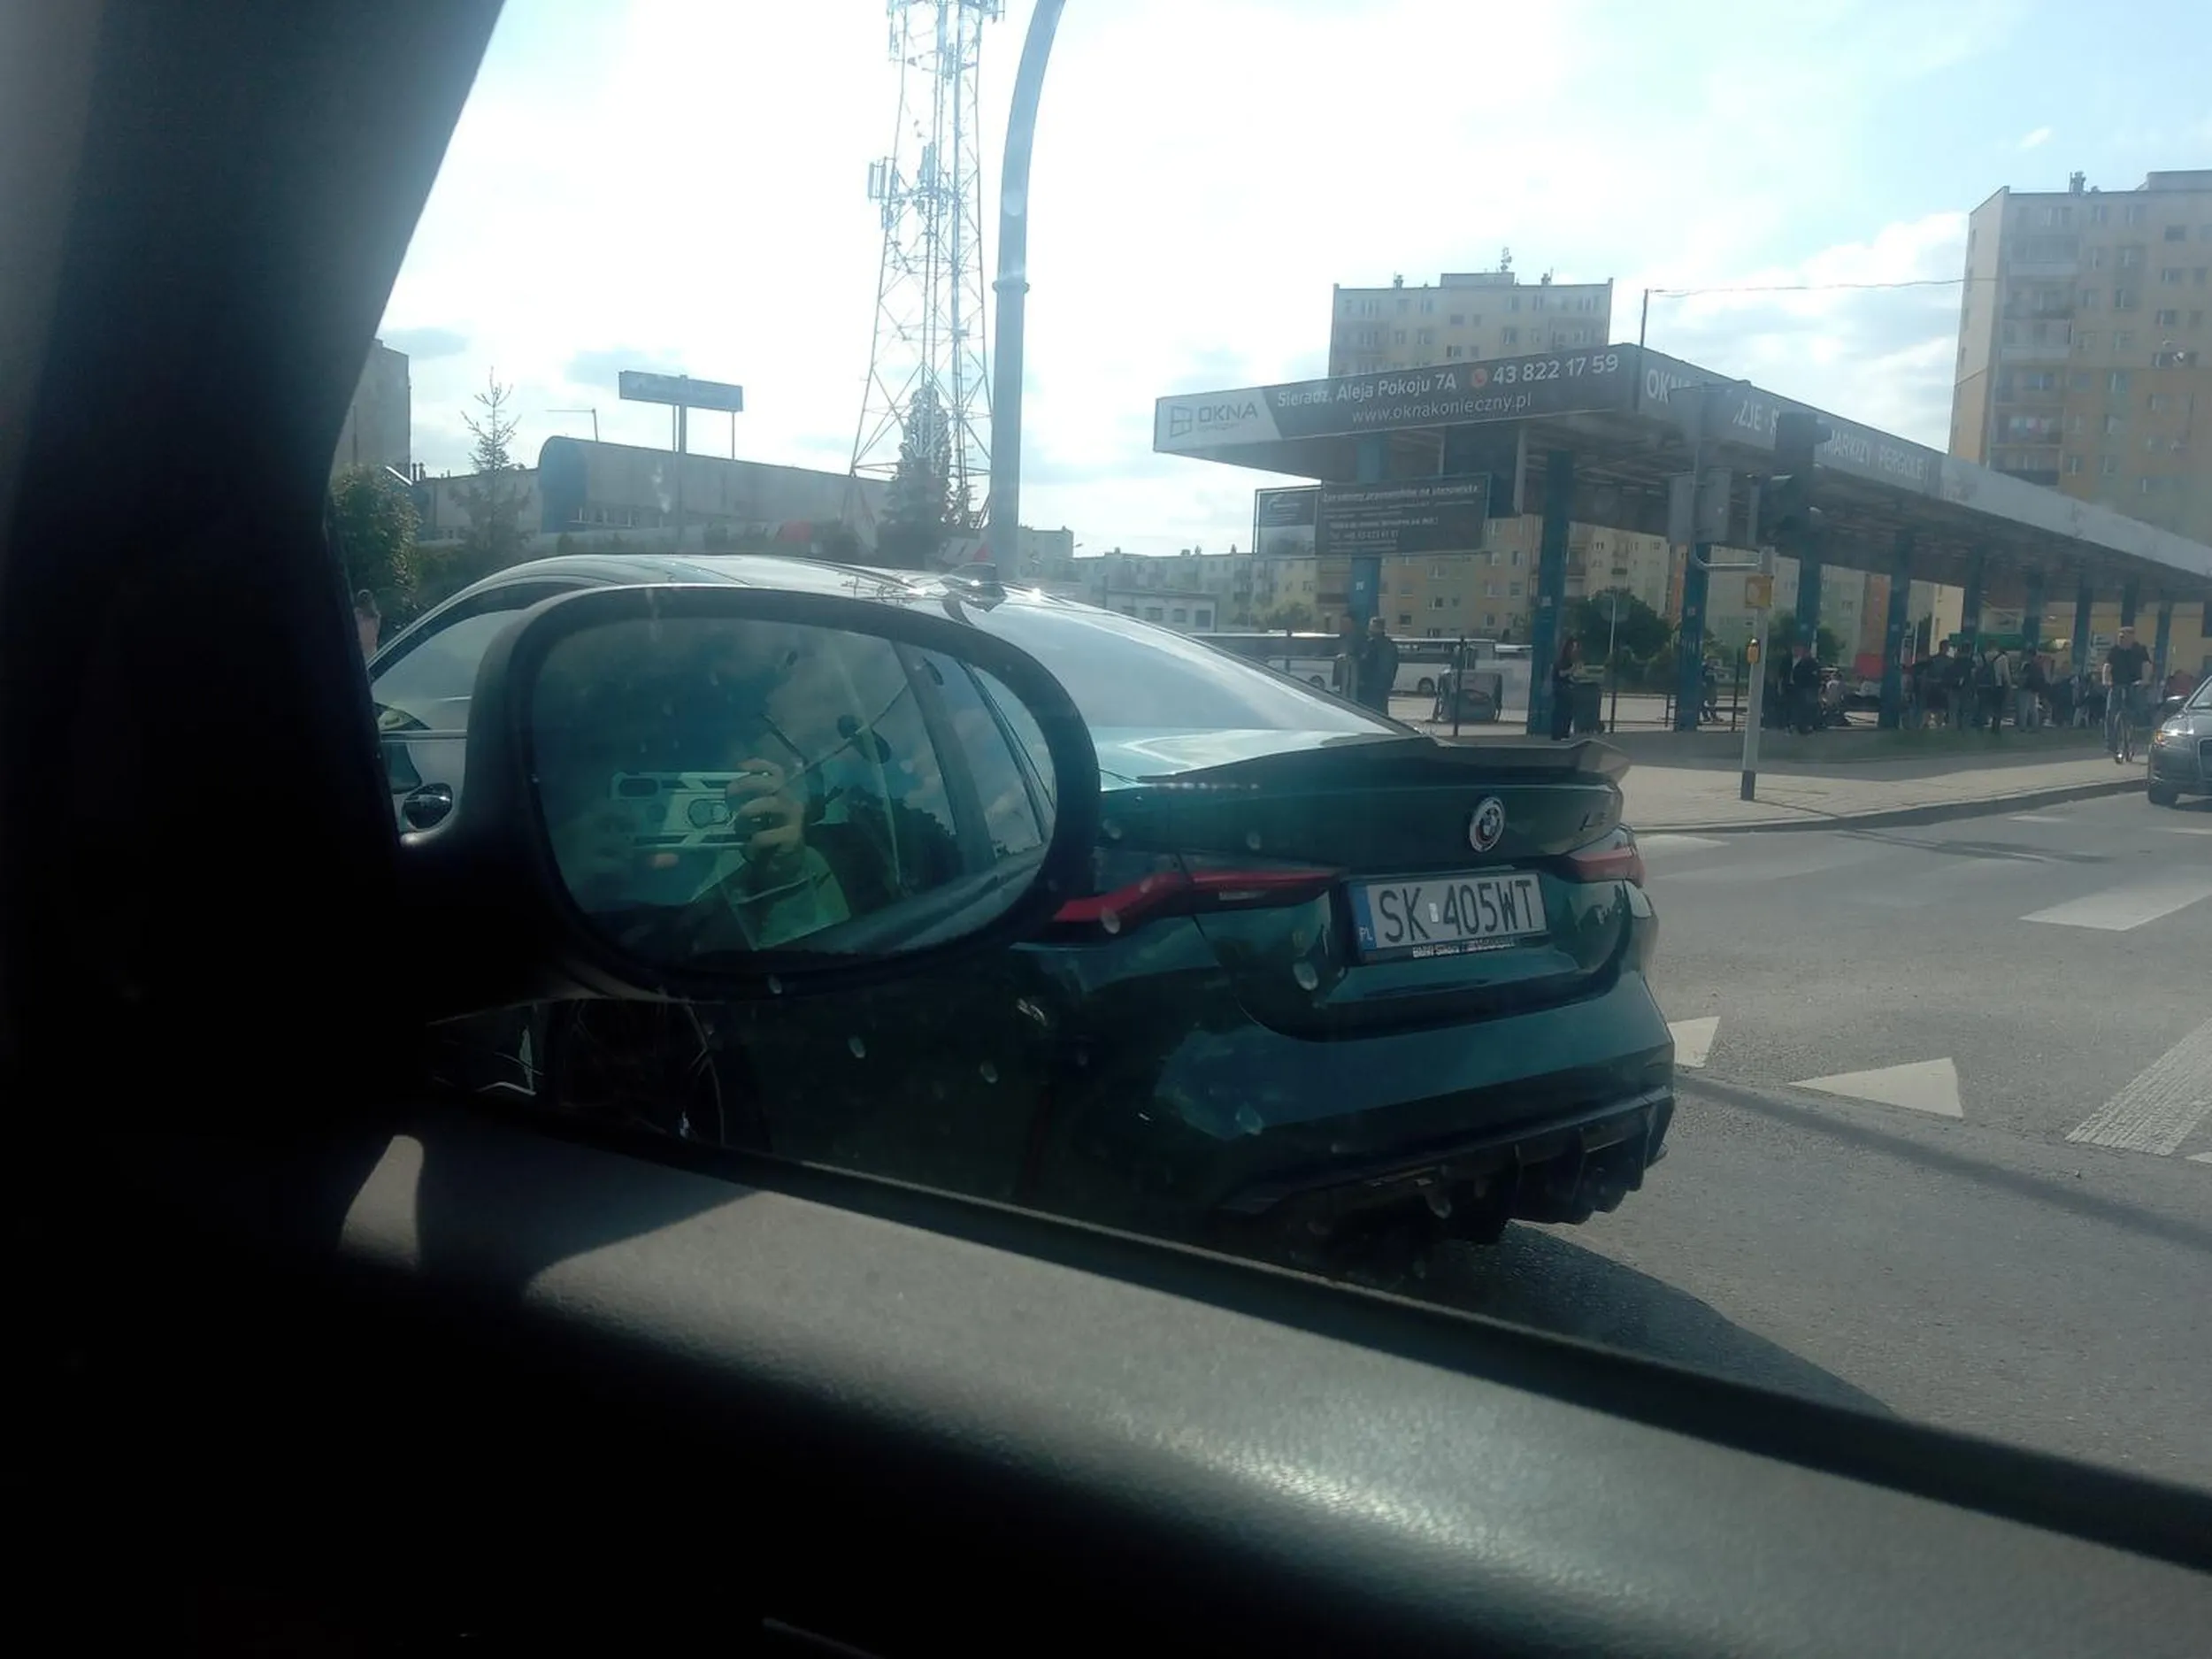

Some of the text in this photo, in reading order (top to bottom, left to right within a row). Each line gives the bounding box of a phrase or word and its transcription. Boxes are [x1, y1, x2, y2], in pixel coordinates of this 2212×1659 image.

[1493, 354, 1618, 384] 43 822 17 59
[1337, 381, 1374, 403] Aleja
[1378, 374, 1431, 396] Pokoju
[1435, 373, 1456, 390] 7A
[1198, 401, 1258, 423] OKNA
[1352, 392, 1532, 423] www.oknakonieczny.pl
[1379, 880, 1532, 942] SK 405WT
